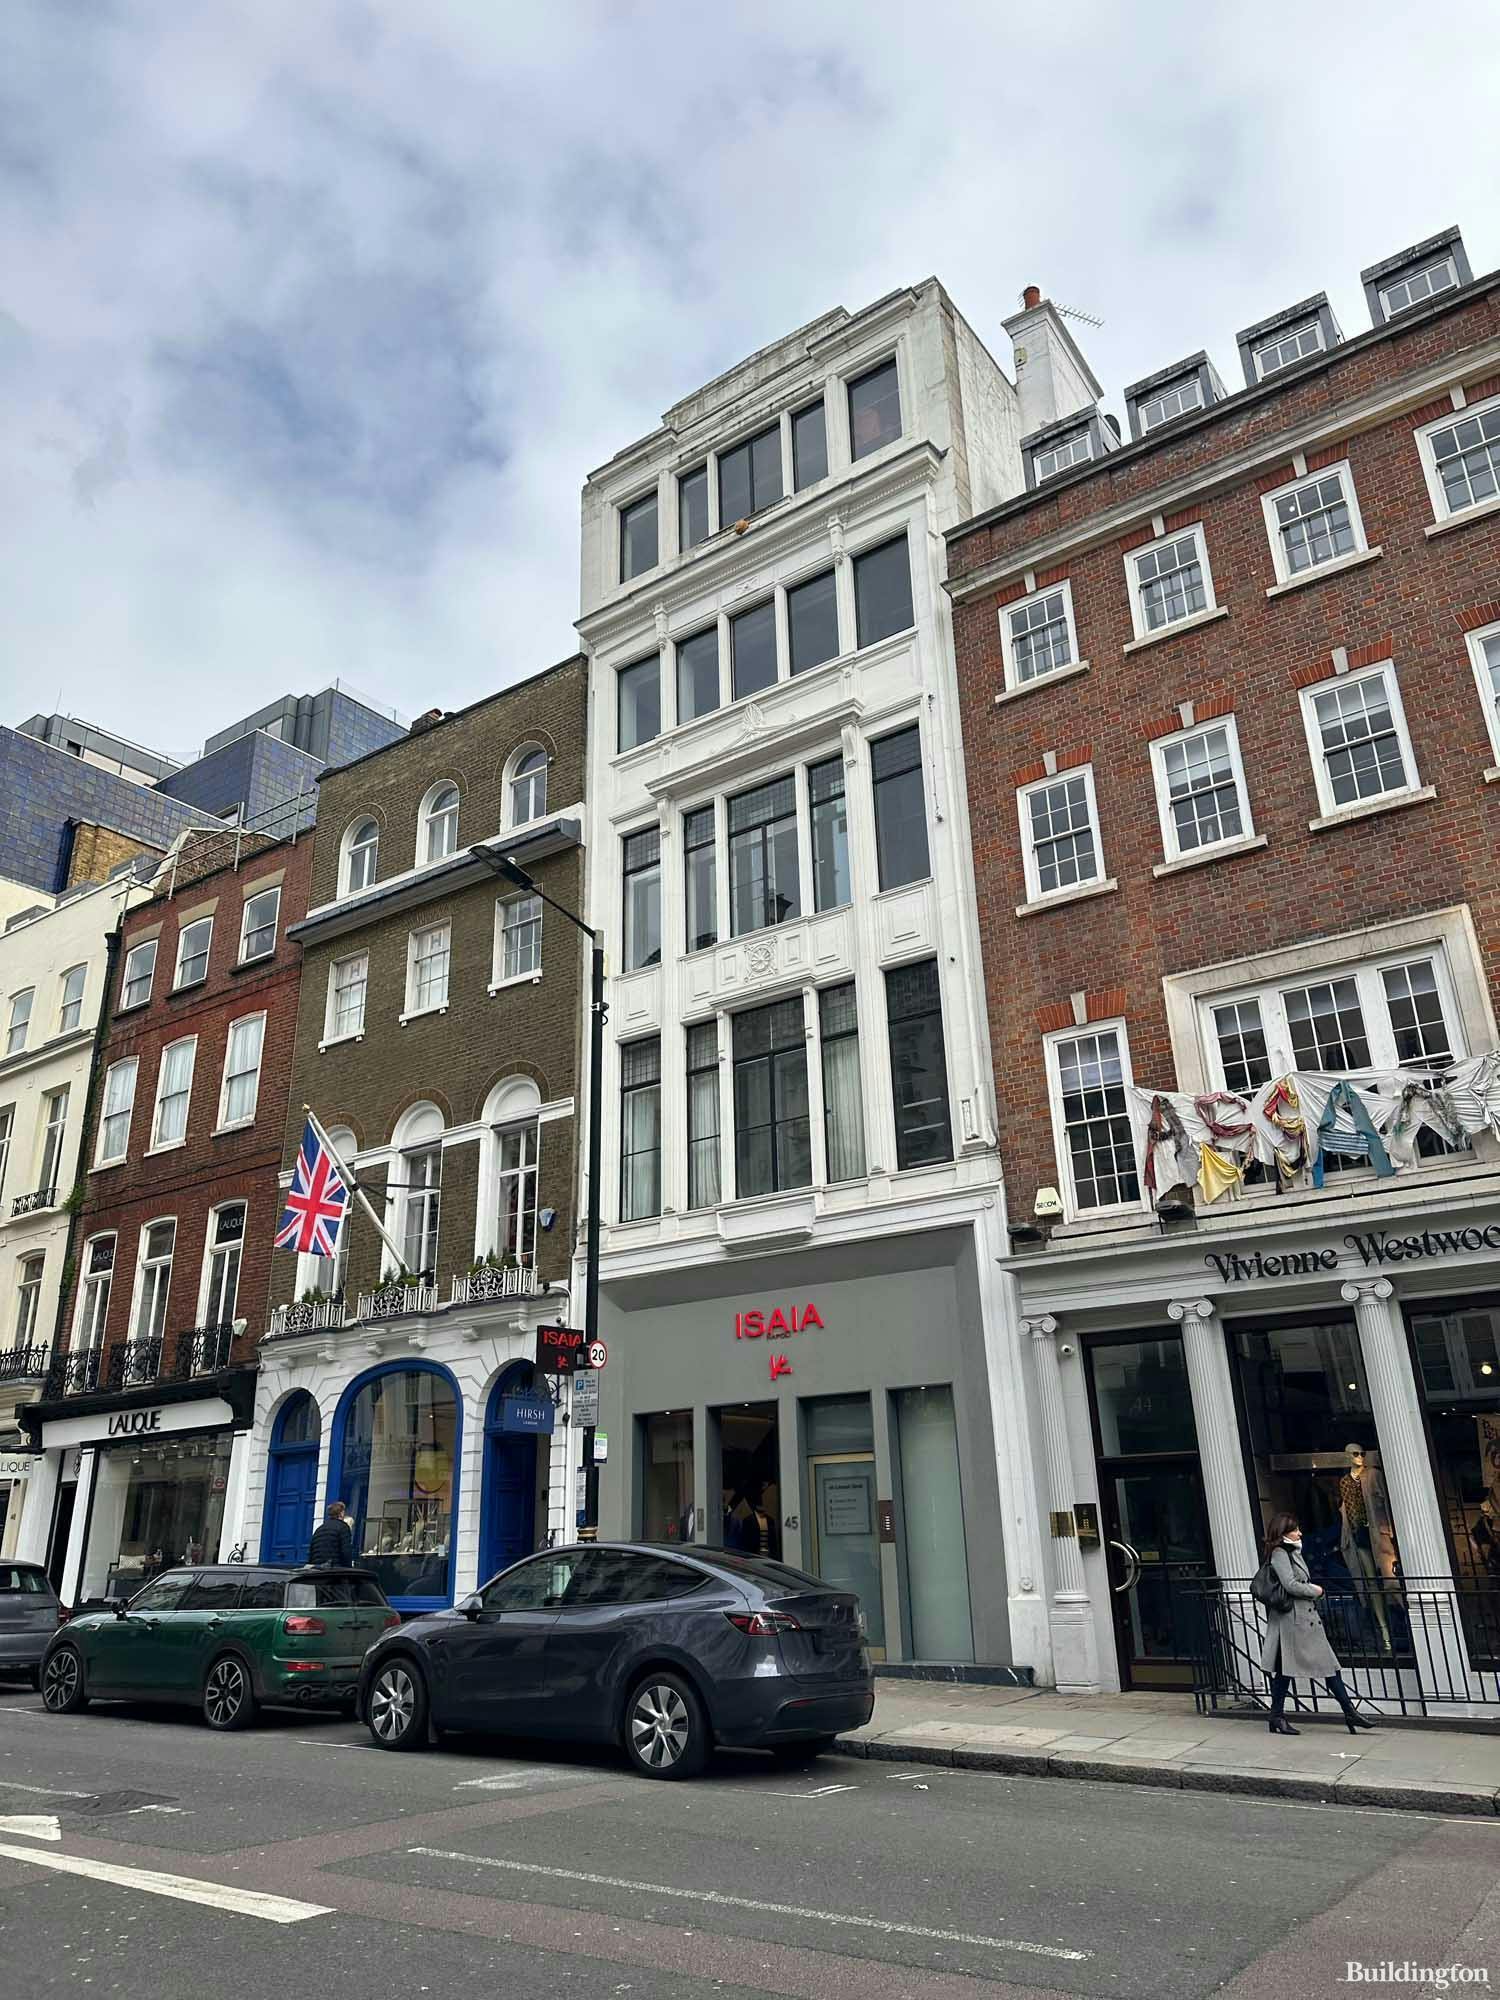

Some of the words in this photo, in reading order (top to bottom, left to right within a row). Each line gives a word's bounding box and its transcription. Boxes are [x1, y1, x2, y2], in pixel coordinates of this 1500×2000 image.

[1037, 1200, 1057, 1209] SECOM
[93, 1248, 114, 1261] LALIQU
[1204, 1248, 1339, 1284] Vivienne
[736, 1303, 824, 1339] ISAIA
[543, 1331, 582, 1347] ISAIA
[592, 1348, 604, 1361] 20
[516, 1408, 545, 1420] HIRSH
[108, 1411, 161, 1434] LALIQUE
[784, 1516, 799, 1530] 45
